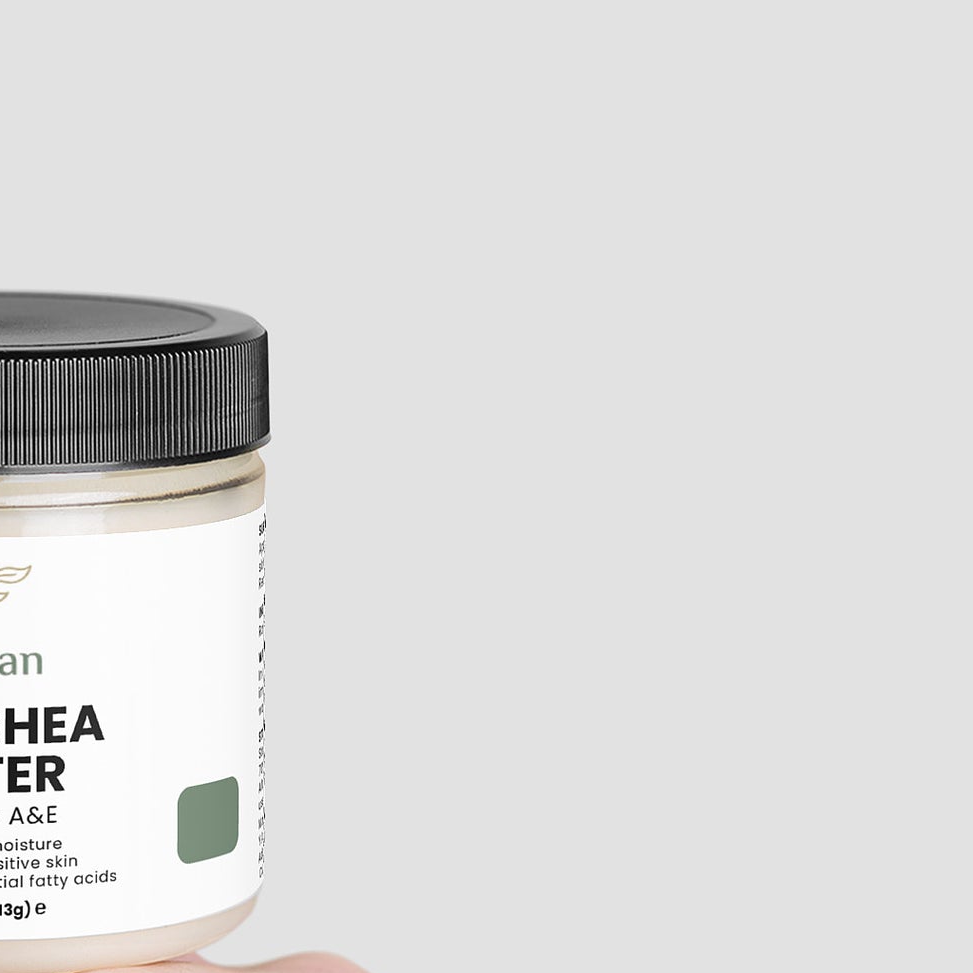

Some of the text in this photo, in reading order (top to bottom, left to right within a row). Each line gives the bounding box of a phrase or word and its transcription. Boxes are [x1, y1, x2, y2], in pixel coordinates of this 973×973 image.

[8, 804, 58, 826] A&E
[45, 854, 78, 870] skin
[28, 873, 69, 891] fatty
[73, 869, 117, 886] acids
